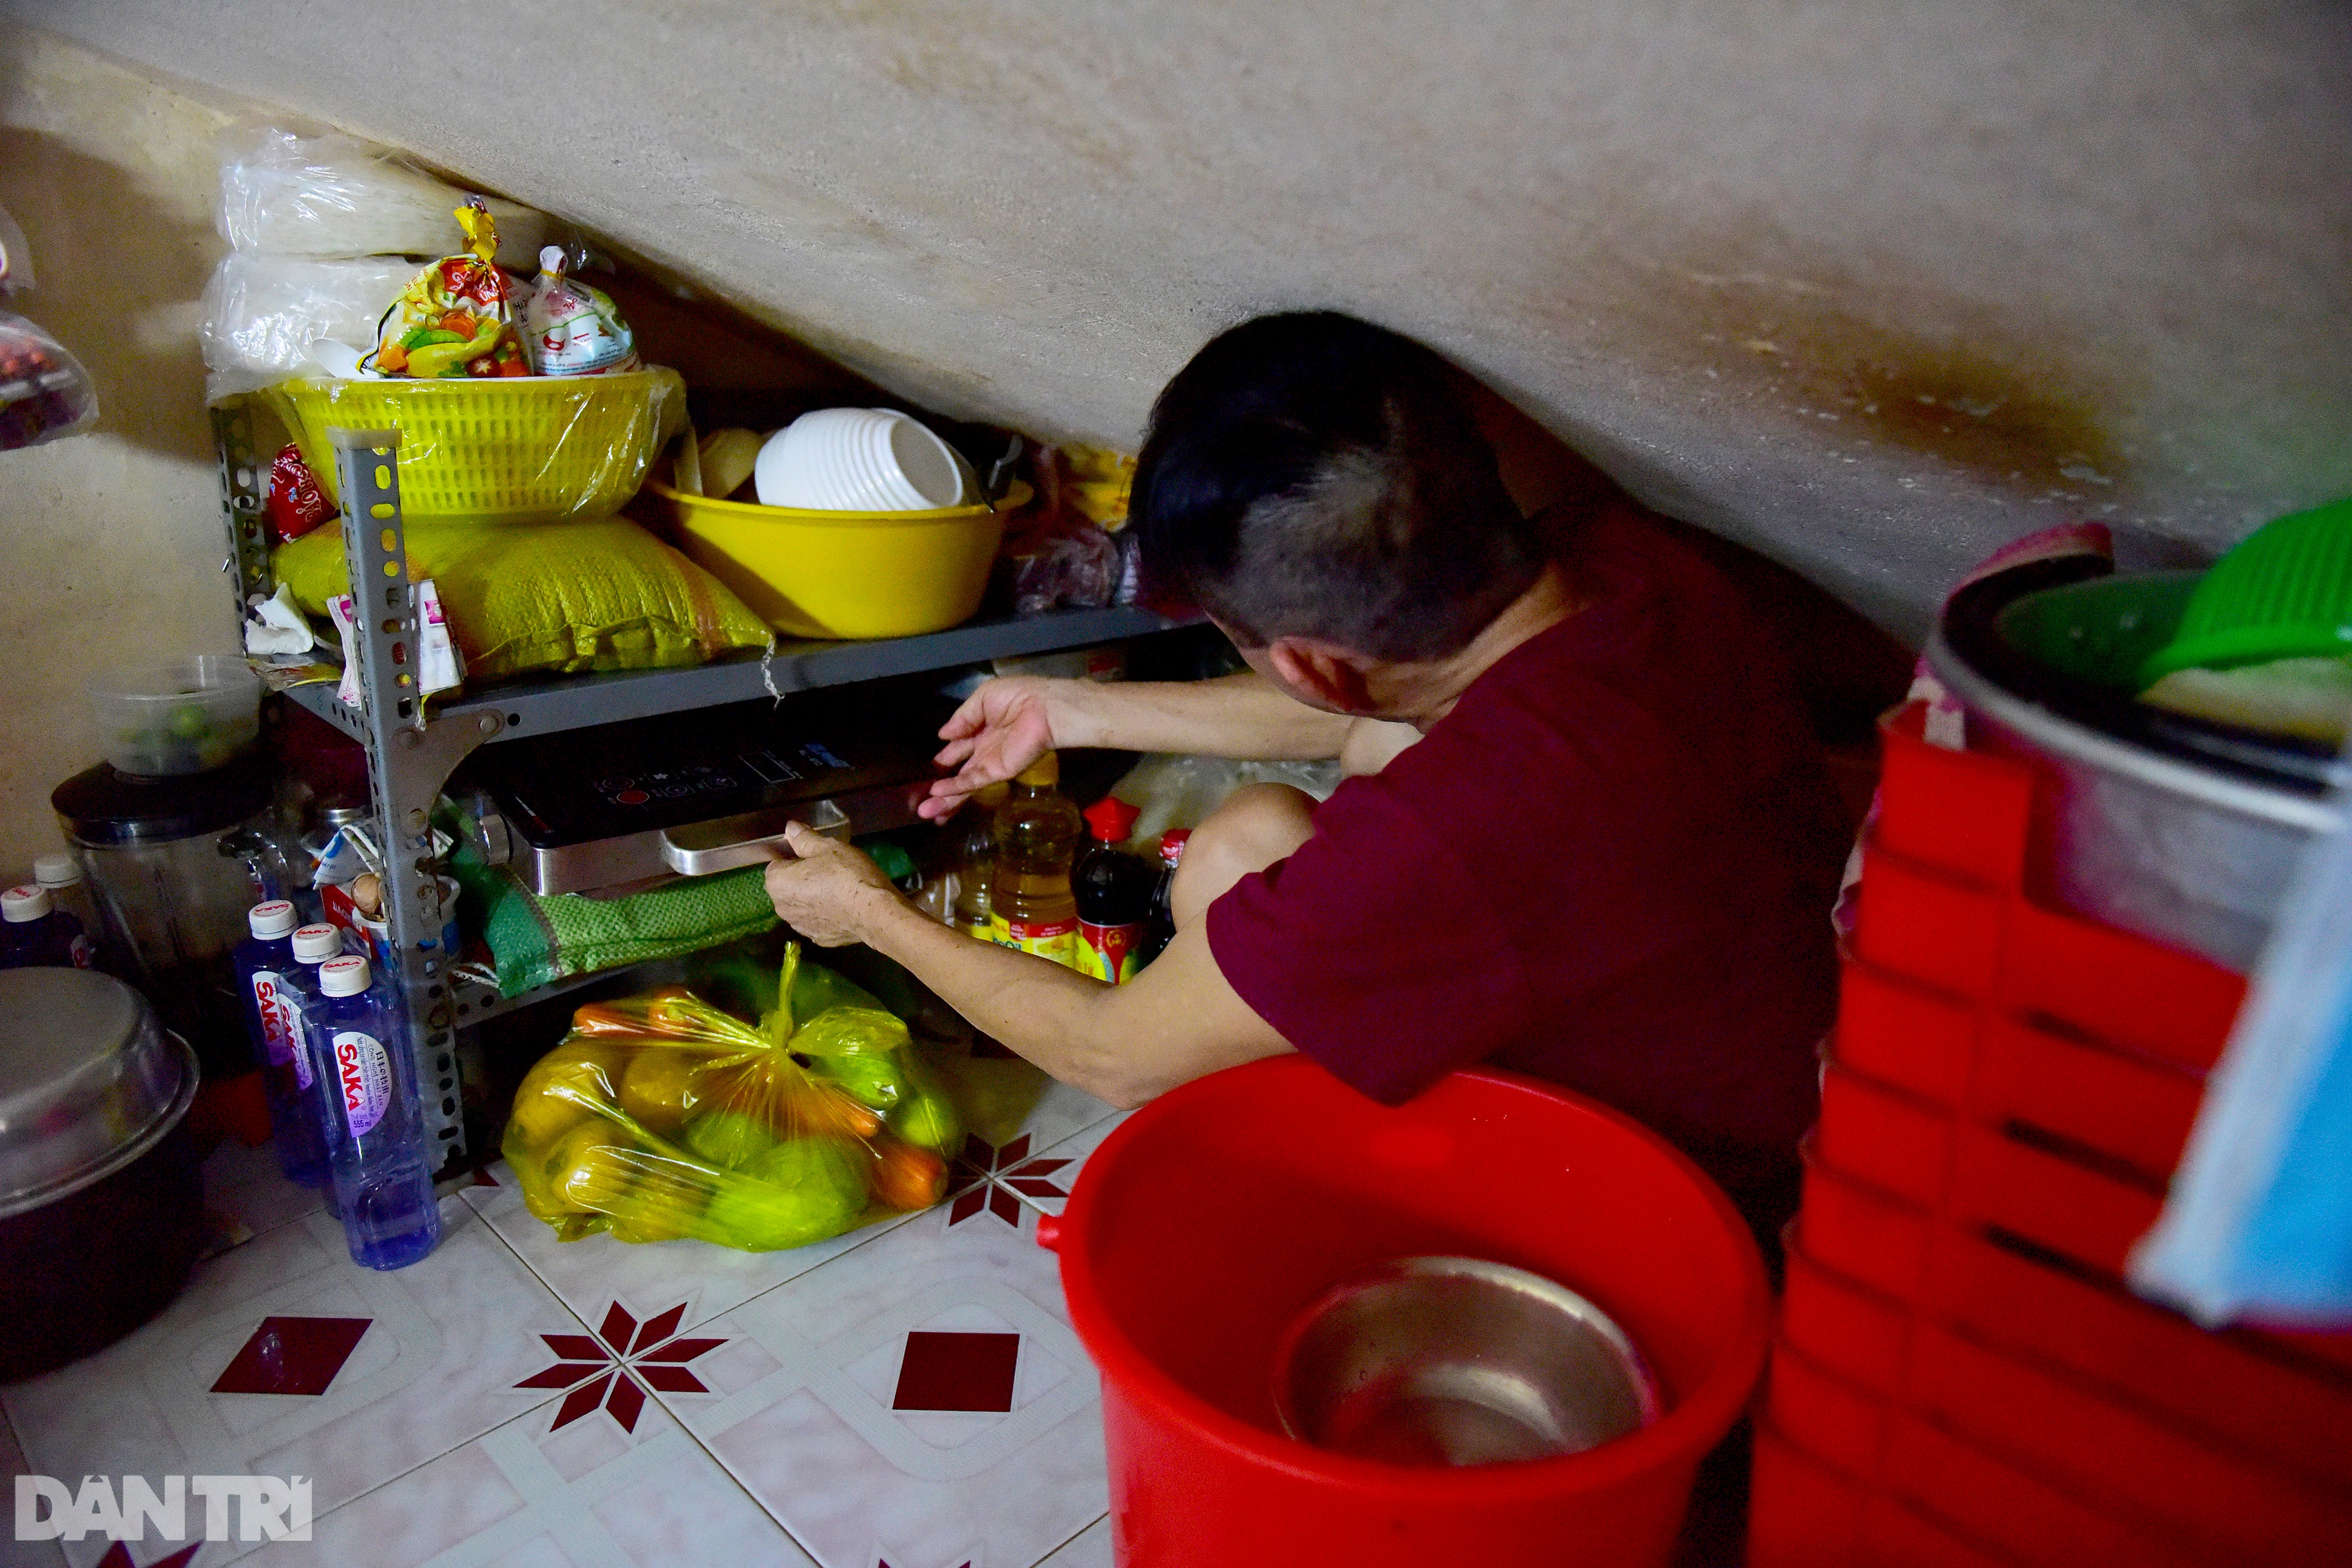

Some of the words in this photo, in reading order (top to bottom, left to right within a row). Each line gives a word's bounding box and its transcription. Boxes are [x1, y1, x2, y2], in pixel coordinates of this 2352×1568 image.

[256, 981, 280, 1042] SAKA
[338, 1044, 365, 1111] SAKA
[353, 1119, 364, 1128] 555
